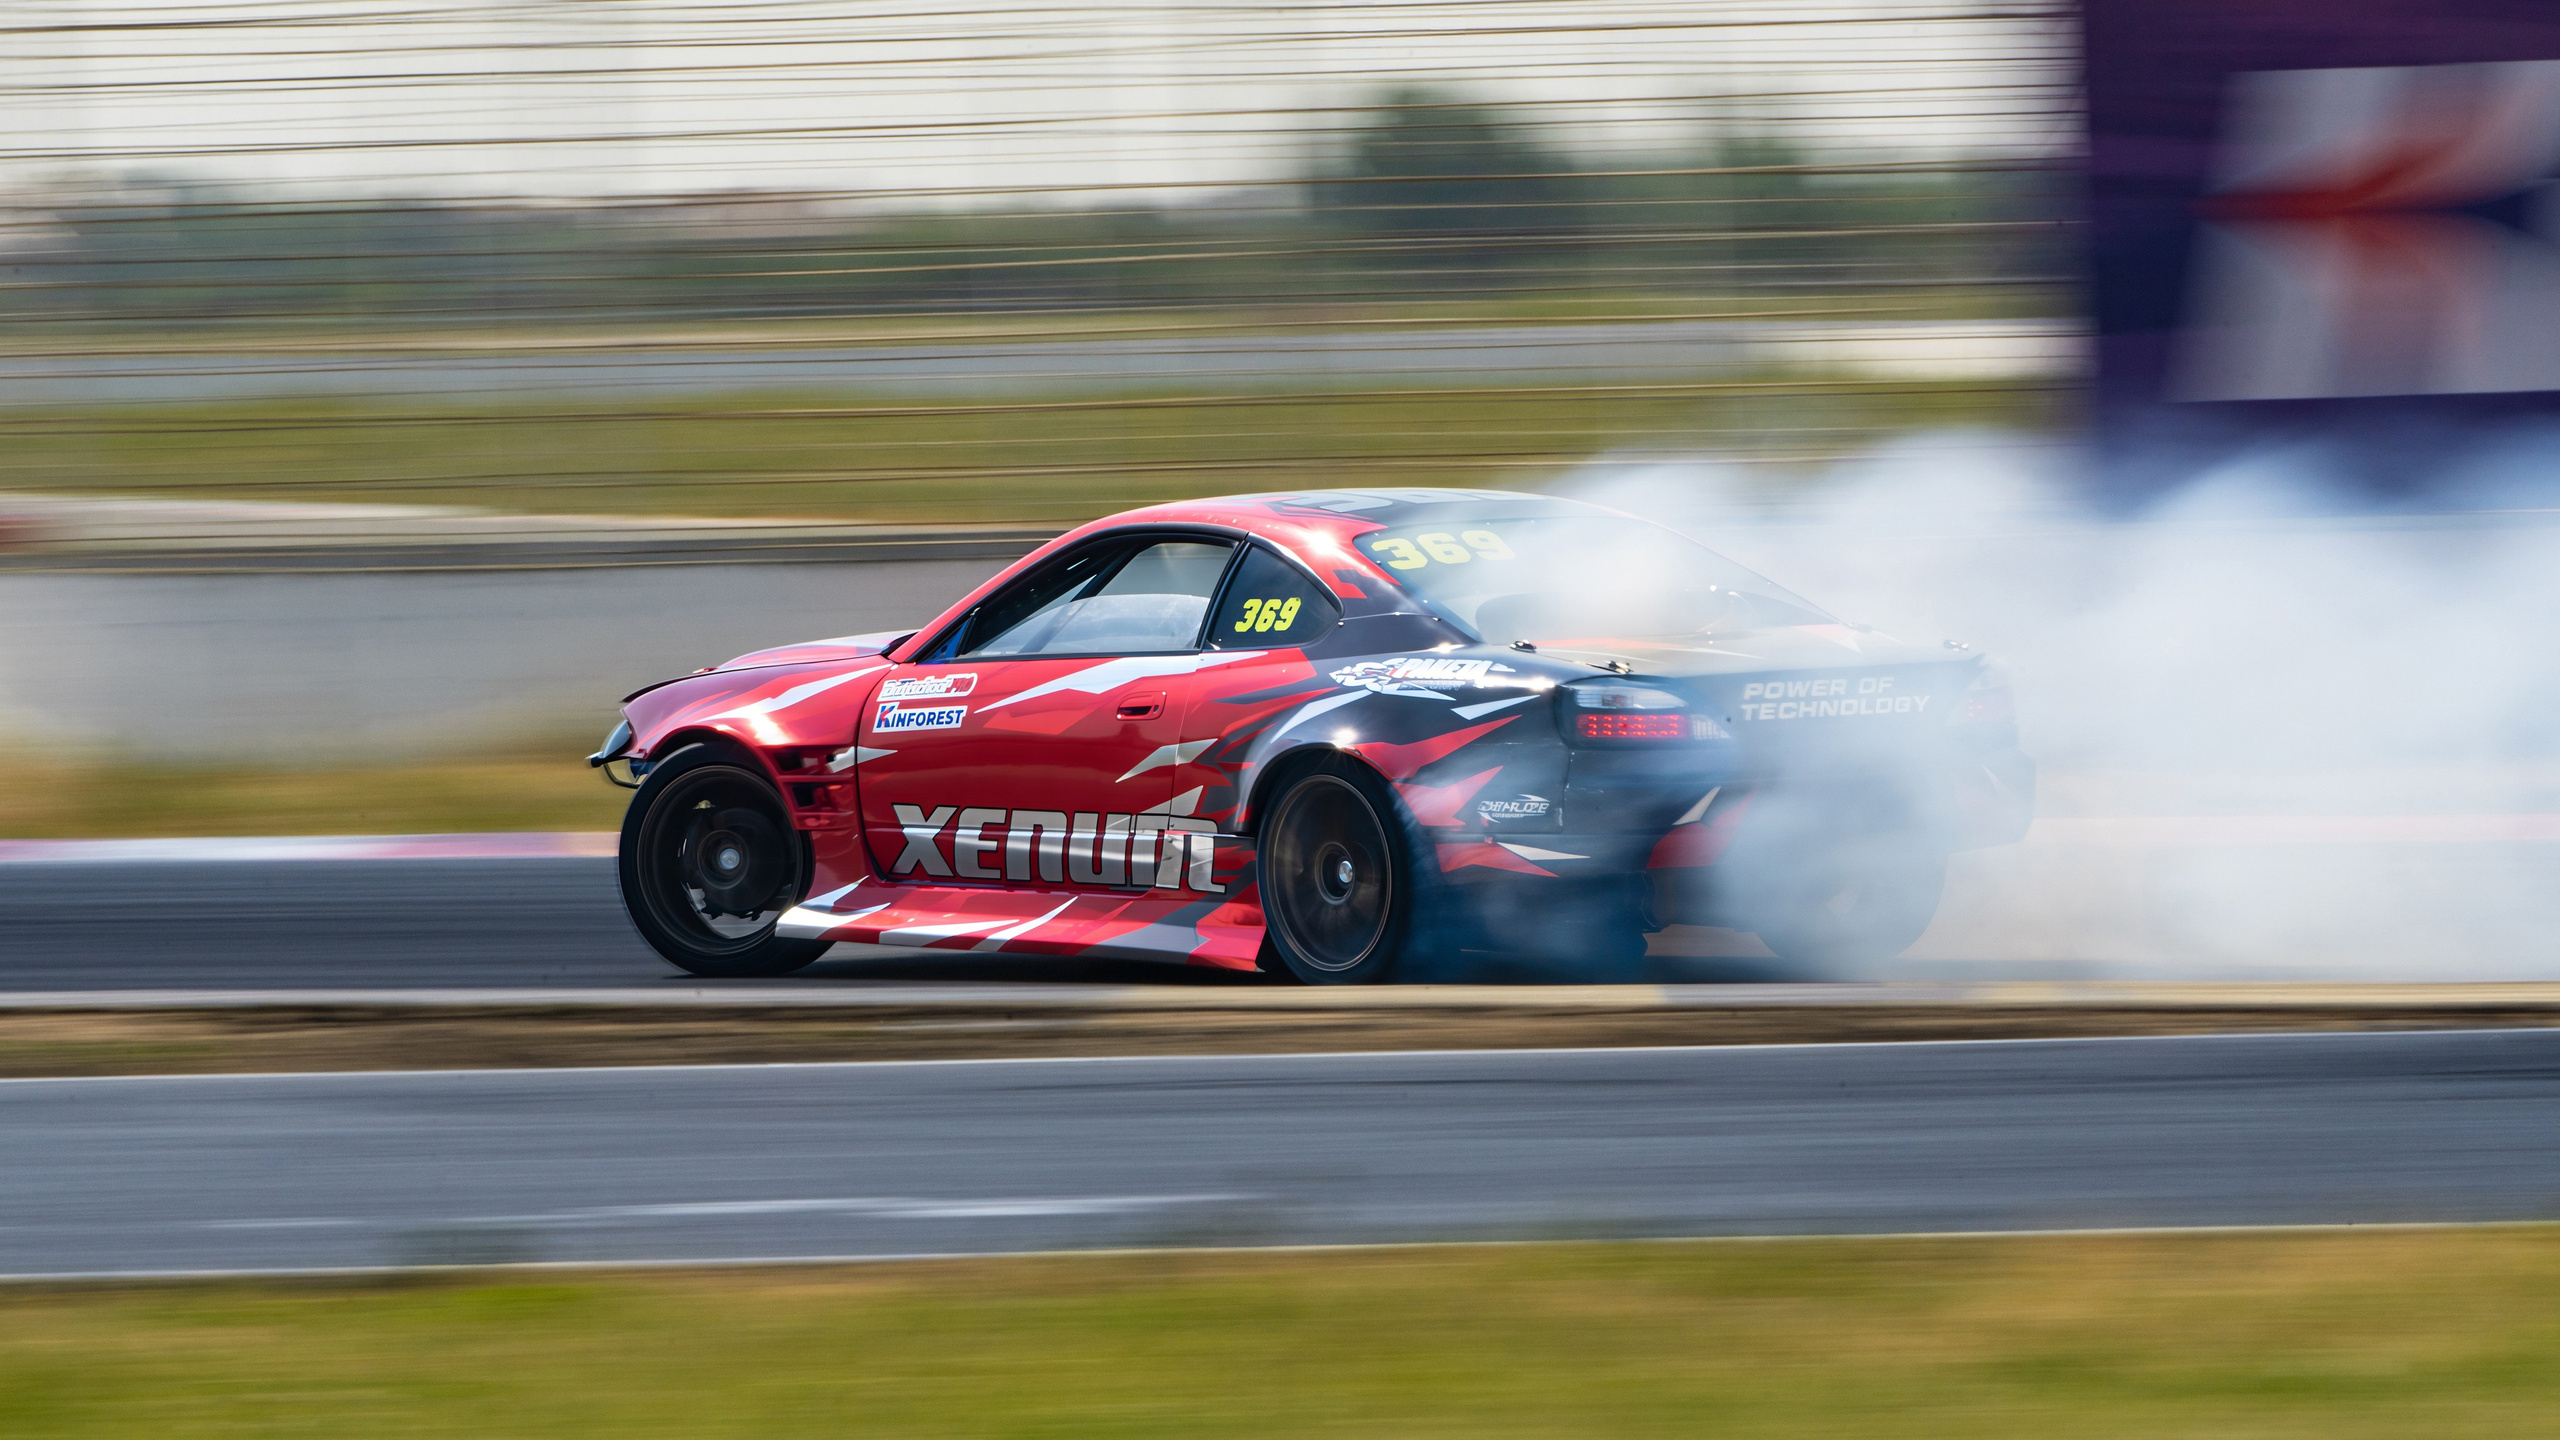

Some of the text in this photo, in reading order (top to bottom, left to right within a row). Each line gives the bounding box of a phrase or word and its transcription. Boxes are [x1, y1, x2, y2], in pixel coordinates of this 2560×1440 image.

[1371, 529, 1516, 570] 369
[1234, 597, 1302, 632] 369
[1743, 676, 1895, 700] POWER OF
[876, 705, 964, 729] KINFOREST
[1741, 695, 1931, 721] TECHNOLOGY
[889, 802, 1227, 894] XENUM
